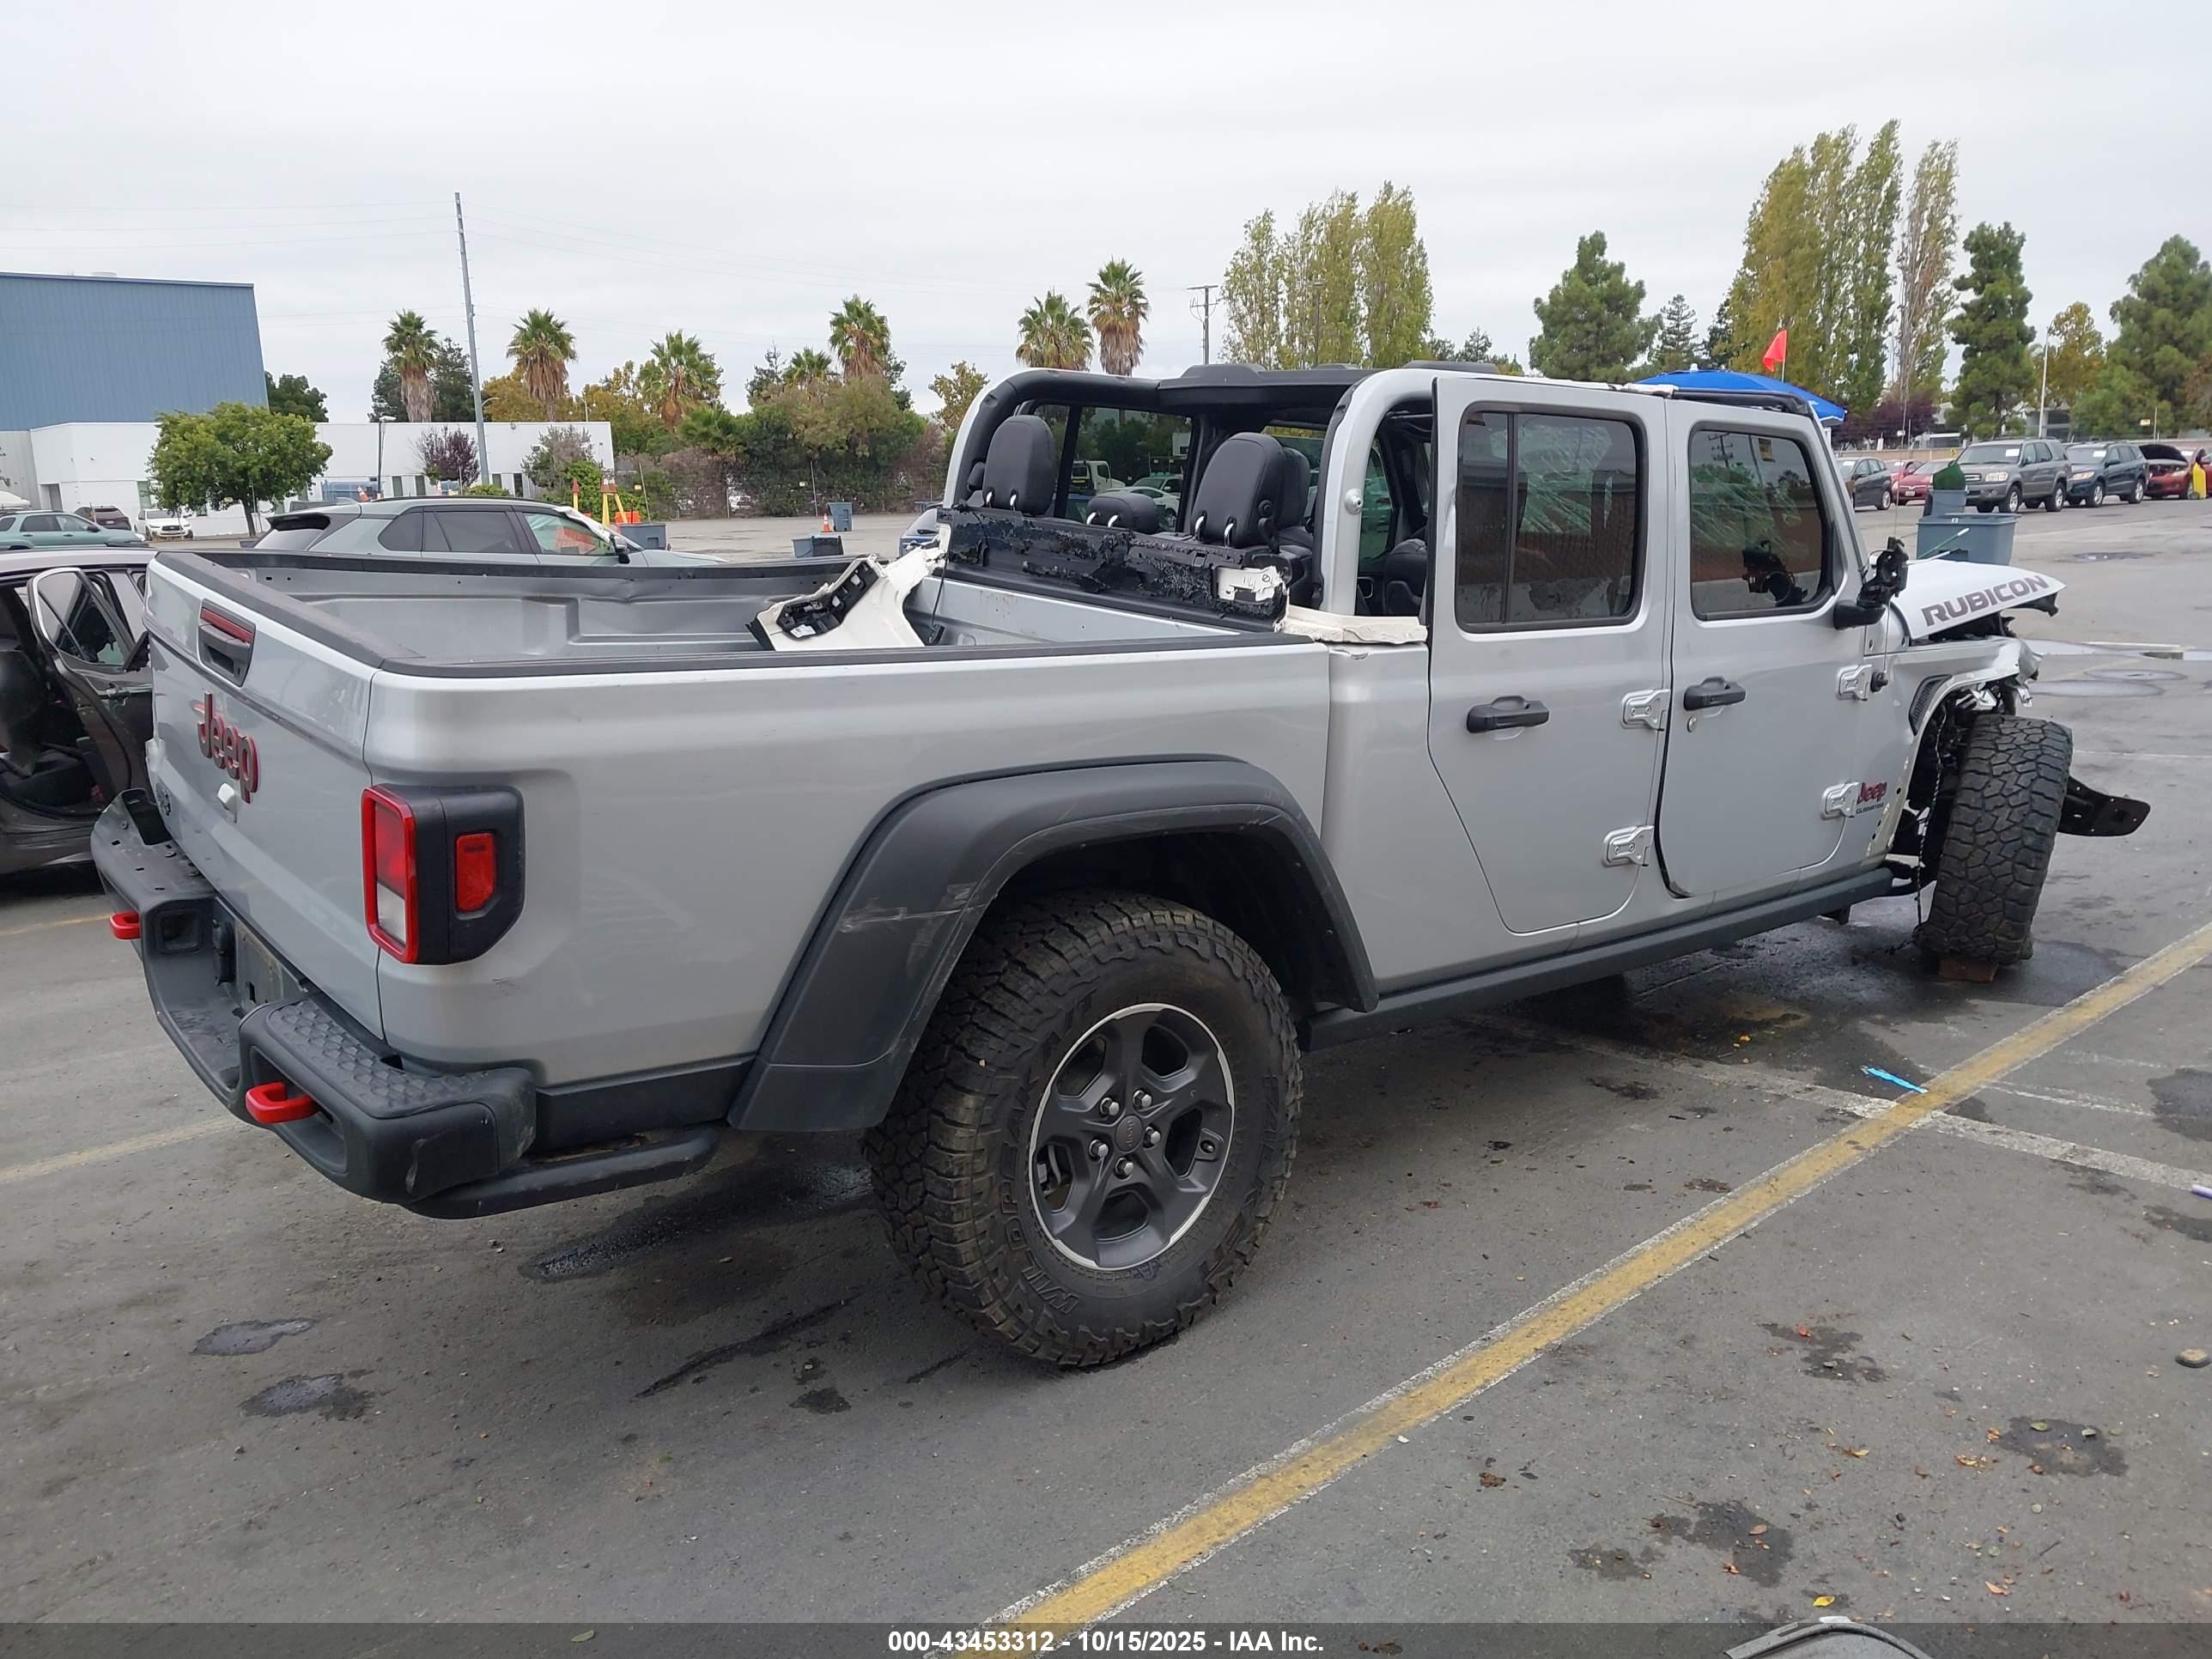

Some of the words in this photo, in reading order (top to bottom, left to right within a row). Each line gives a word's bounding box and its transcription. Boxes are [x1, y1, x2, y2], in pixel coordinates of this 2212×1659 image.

[1921, 574, 2050, 627] RUBICON
[196, 692, 260, 805] Jeep
[1856, 781, 1887, 805] Jeep
